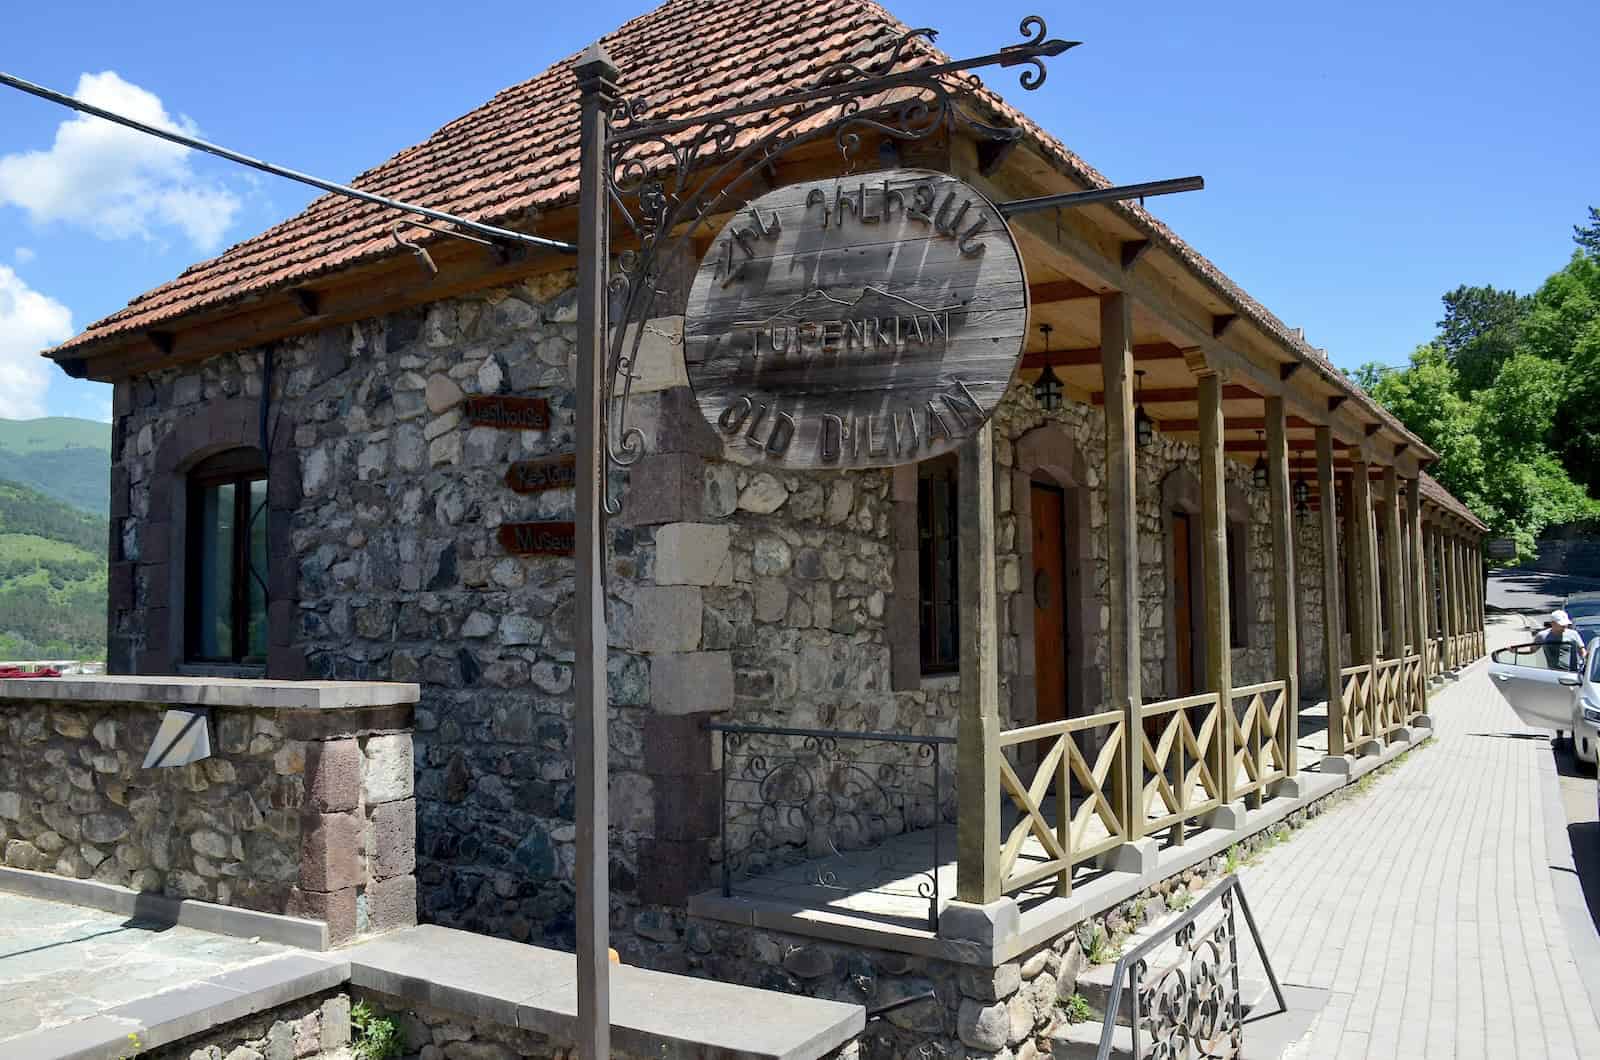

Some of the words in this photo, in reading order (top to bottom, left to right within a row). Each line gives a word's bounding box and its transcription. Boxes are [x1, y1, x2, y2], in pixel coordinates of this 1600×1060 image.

[747, 311, 950, 360] TUFENKIAN
[718, 397, 795, 457] OLD
[514, 527, 577, 552] Museu
